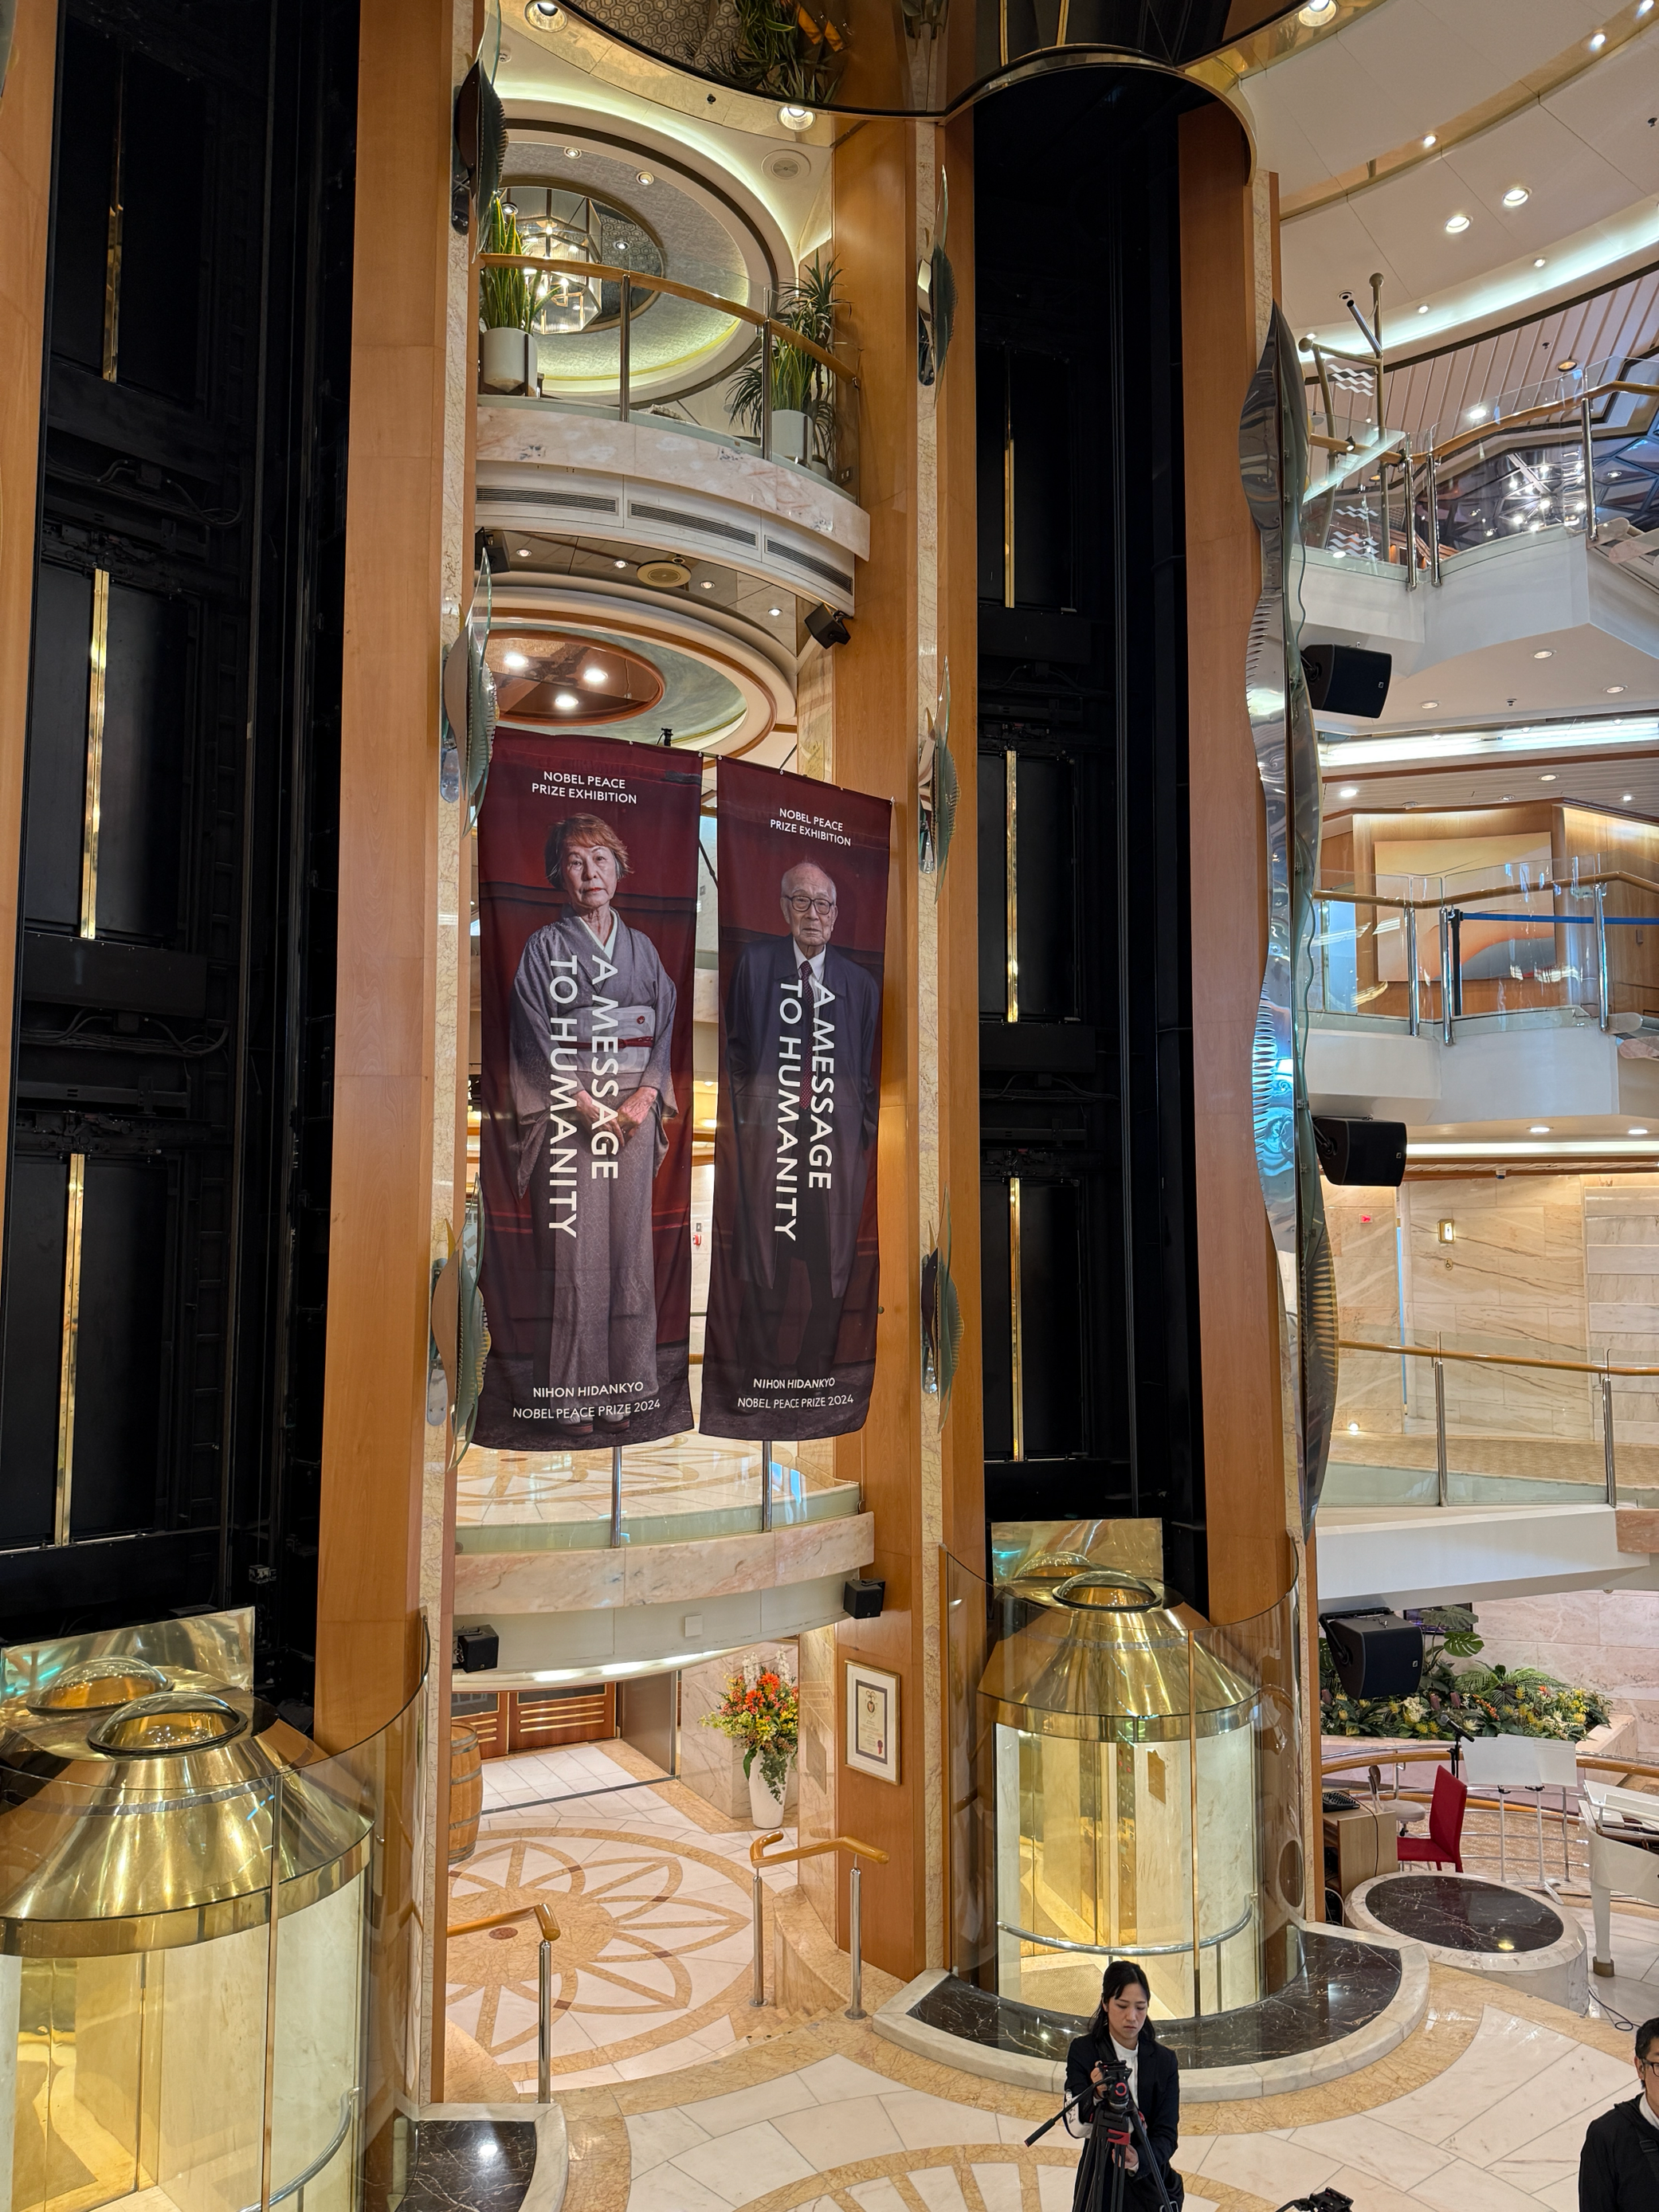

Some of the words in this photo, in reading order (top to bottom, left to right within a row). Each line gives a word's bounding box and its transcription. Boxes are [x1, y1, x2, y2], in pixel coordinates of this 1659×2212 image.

[531, 782, 566, 798] PRIZE
[567, 788, 637, 805] EXHIBITION
[543, 771, 586, 785] NOBEL
[587, 775, 626, 789] PEACE
[770, 818, 797, 833] PRIZE
[799, 825, 851, 846] EXHIBITION
[779, 807, 812, 824] NOBEL
[814, 816, 843, 832] PEACE
[550, 955, 578, 1004] TO
[591, 954, 618, 985] A
[779, 979, 803, 1025] TO
[812, 980, 837, 1009] A
[590, 994, 619, 1180] MESSAGE
[808, 1017, 836, 1190] MESSAGE
[548, 1017, 578, 1239] HUMANITY
[774, 1036, 802, 1242] HUMANITY
[532, 1386, 575, 1398] NIHON
[578, 1381, 644, 1397] HIDANKYO
[753, 1378, 786, 1389] NIHON
[787, 1377, 836, 1389] HIDANKYO
[512, 1406, 555, 1419] NOBEL
[556, 1406, 595, 1419] PEACE
[598, 1403, 631, 1417] PRIZE
[633, 1398, 661, 1413] 2024
[737, 1398, 771, 1409] NOBEL
[773, 1398, 800, 1409] PEACE
[801, 1397, 826, 1408] PRIZE
[827, 1394, 854, 1406] 2024
